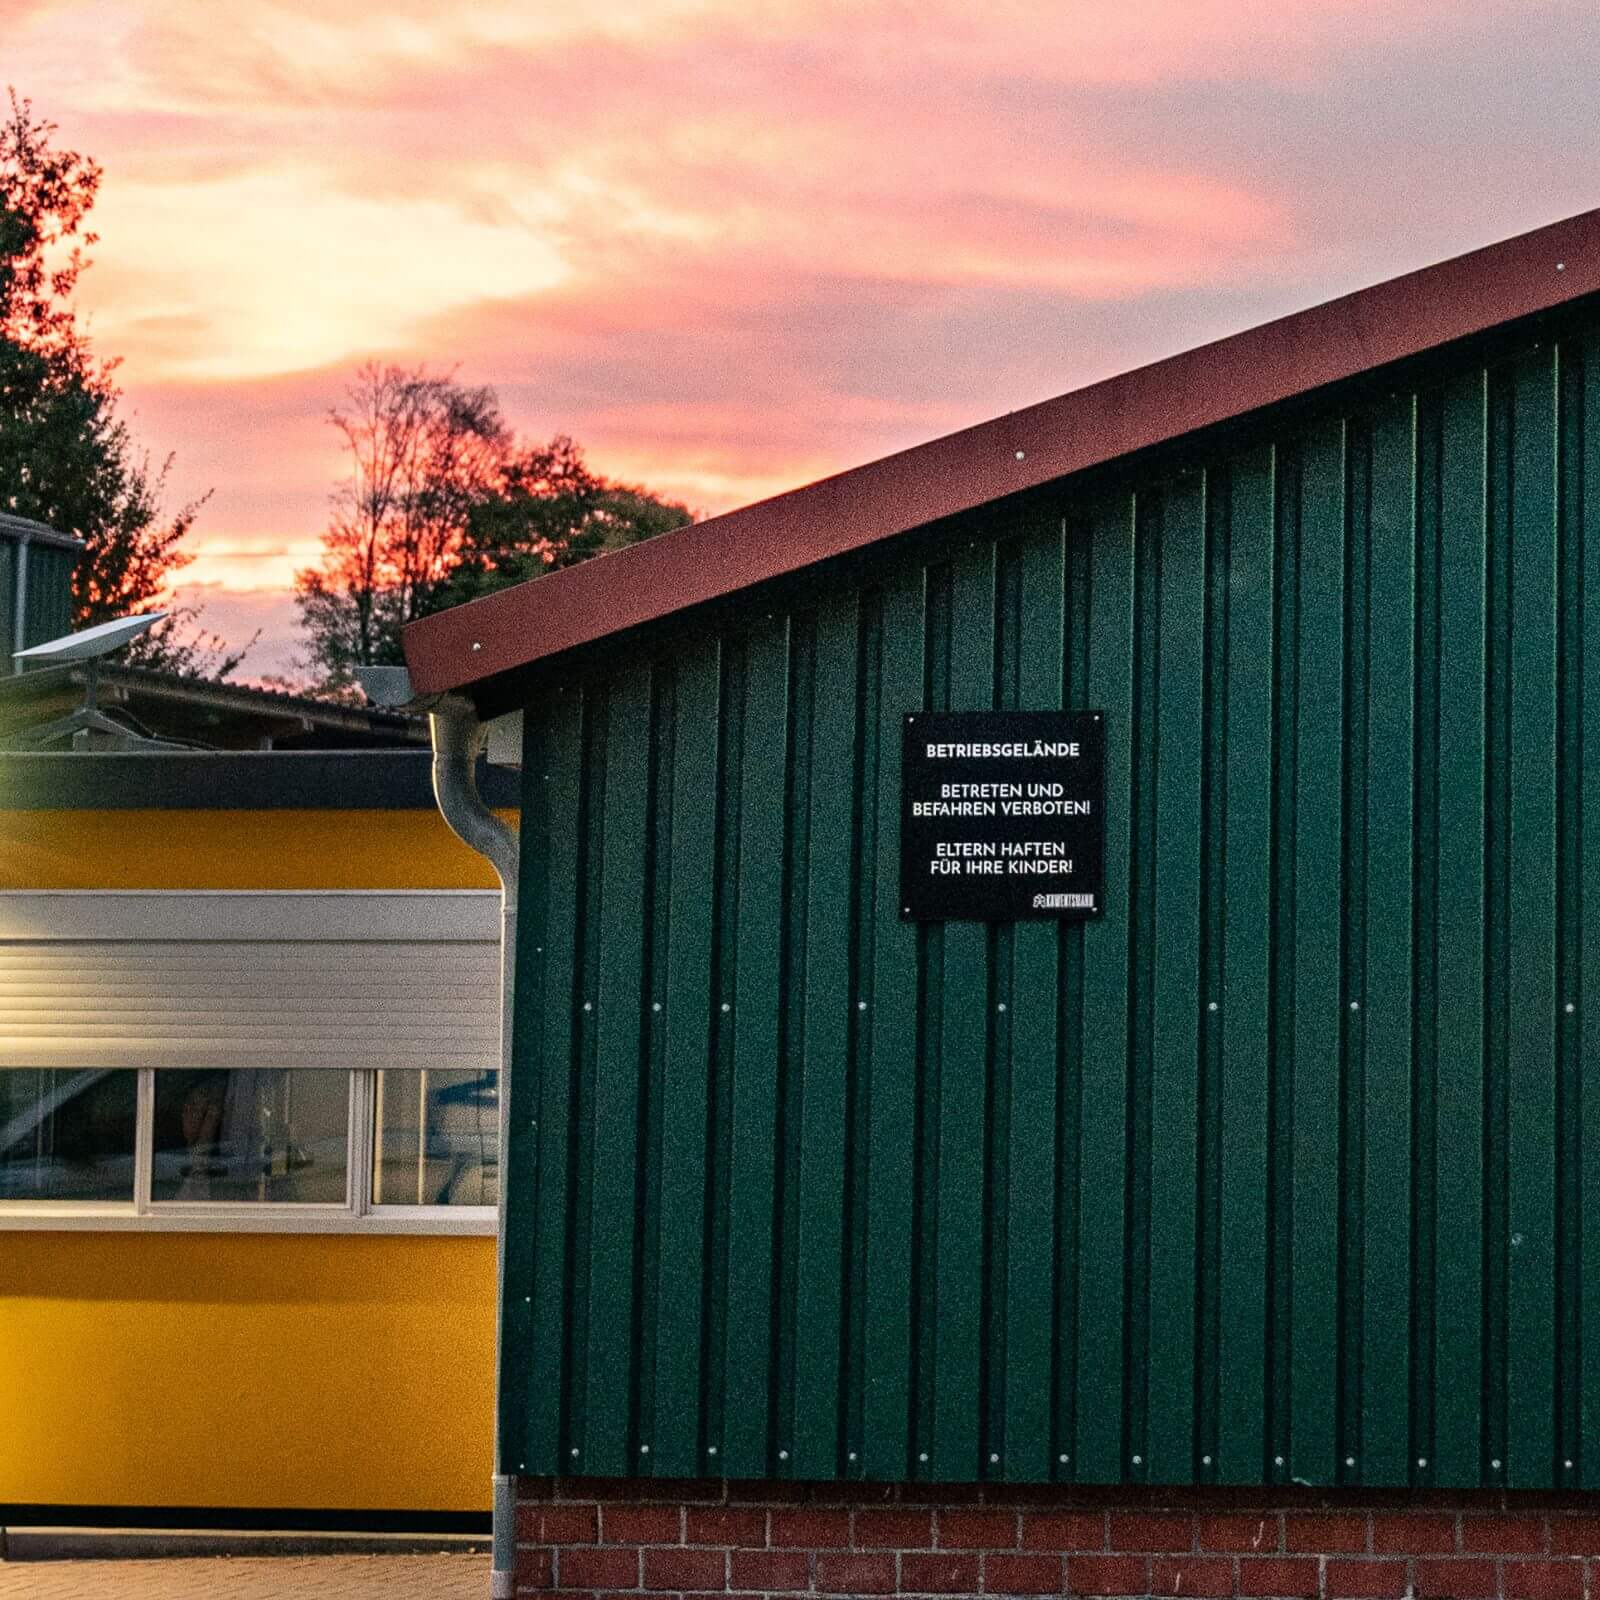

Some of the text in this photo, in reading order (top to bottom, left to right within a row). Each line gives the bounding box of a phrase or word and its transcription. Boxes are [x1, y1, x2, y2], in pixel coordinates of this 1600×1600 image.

[926, 740, 1080, 758] BETRIEBSGELÄNDE
[941, 783, 1064, 798] BETRETEN UND
[912, 800, 1091, 816] BEFAHREN VERBOTEN!
[936, 842, 1065, 857] ELTERN HAFTEN
[930, 858, 1073, 875] FÜR IHRE KINDER!
